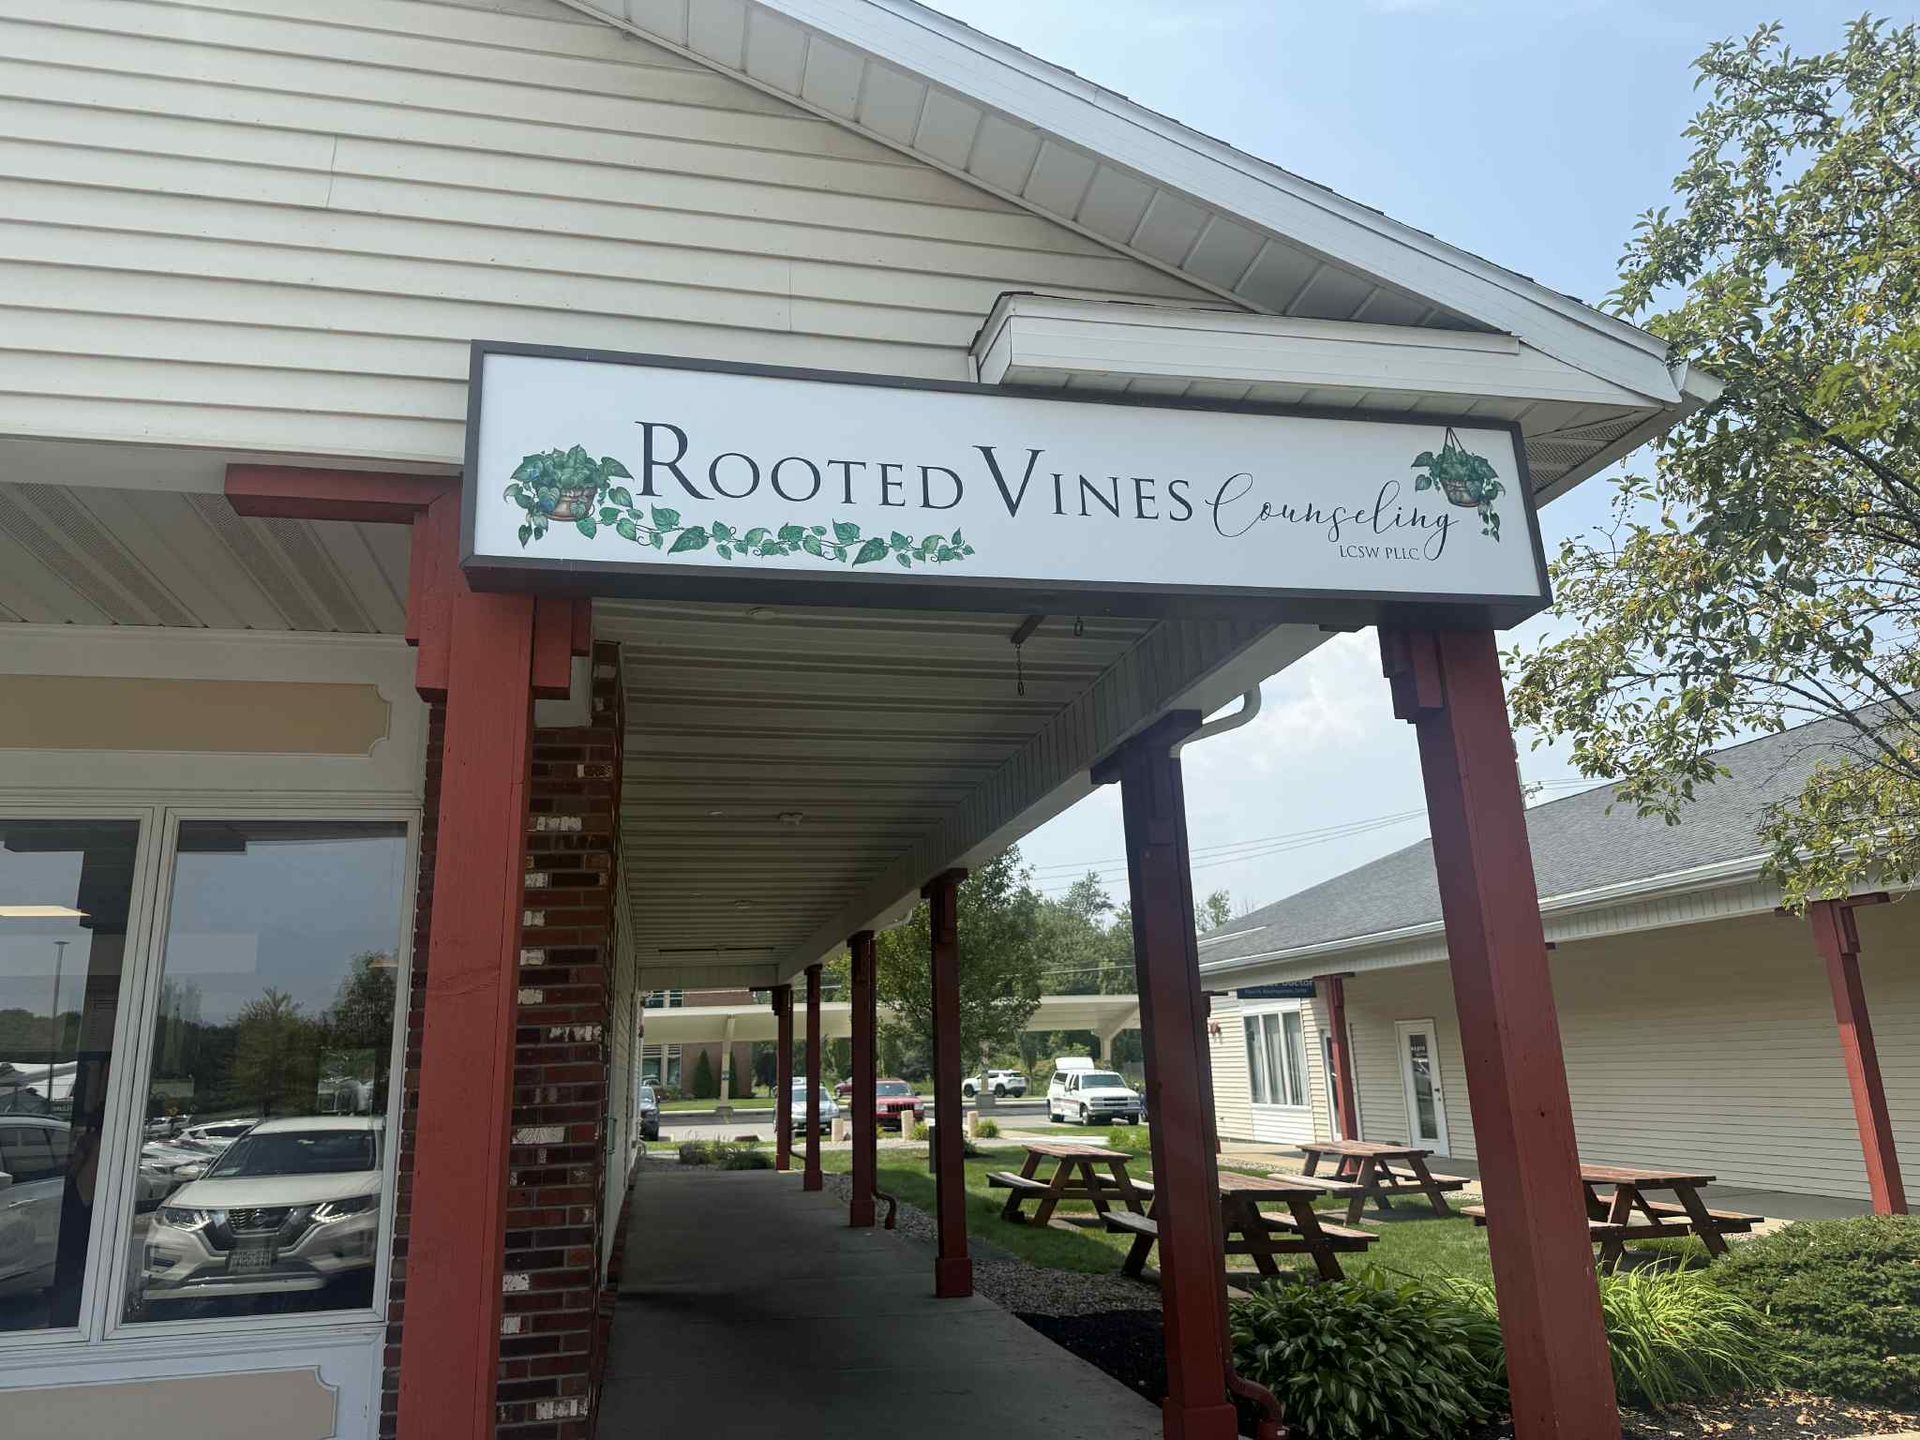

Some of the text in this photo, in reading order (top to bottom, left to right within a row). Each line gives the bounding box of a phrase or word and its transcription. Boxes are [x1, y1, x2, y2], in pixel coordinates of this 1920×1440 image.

[634, 420, 1460, 562] ROOTED VINES Counseling
[1339, 545, 1420, 561] LCSW PLLC
